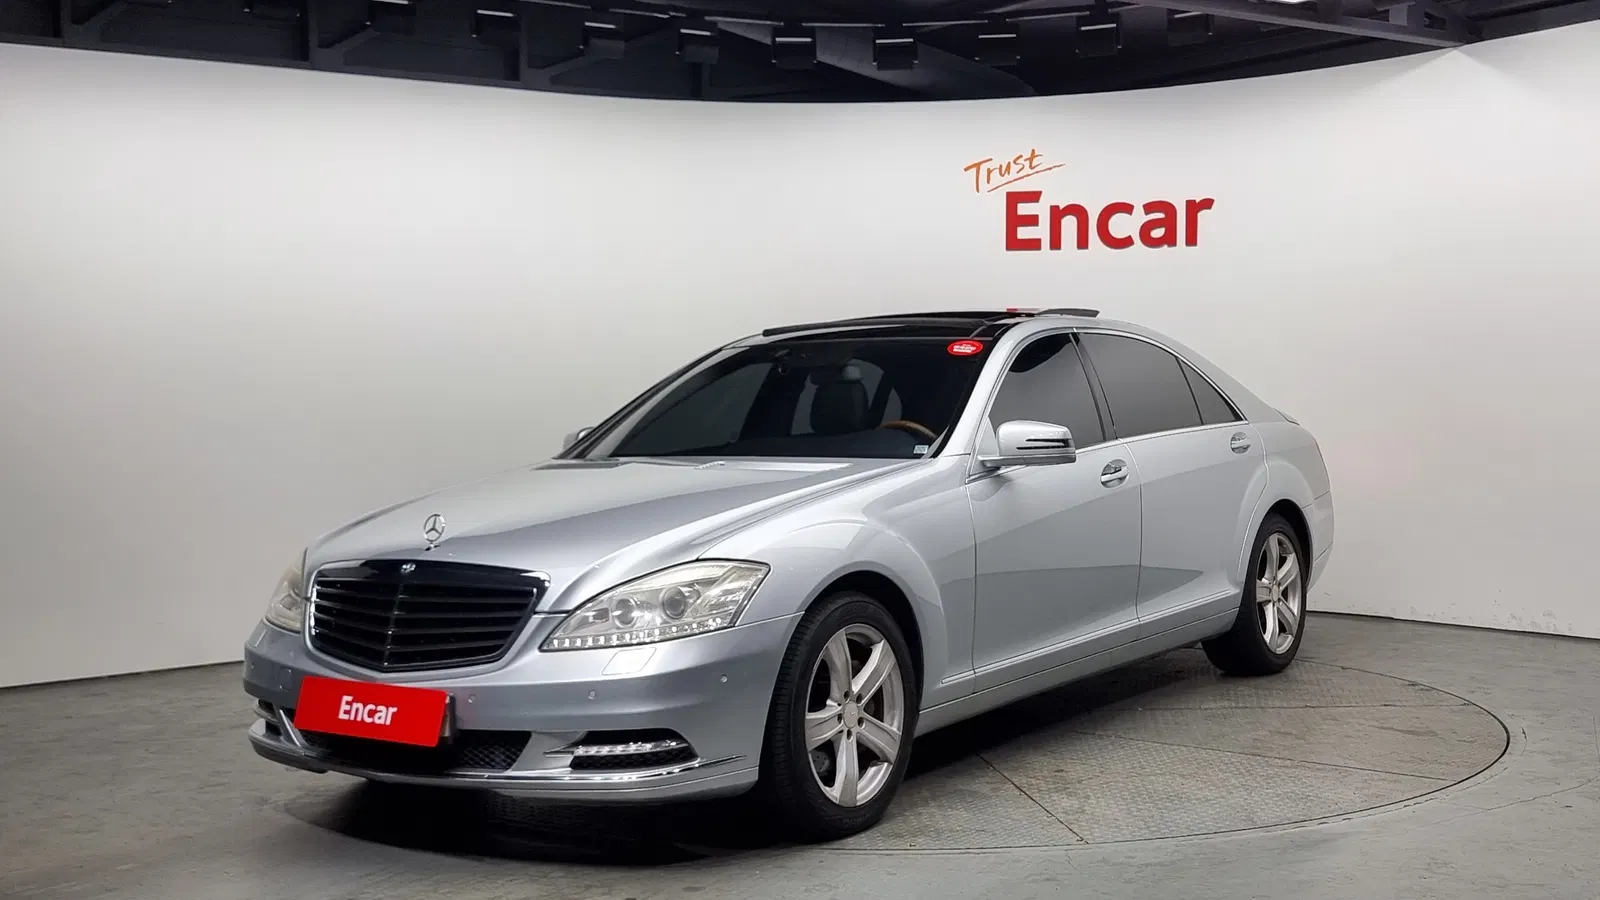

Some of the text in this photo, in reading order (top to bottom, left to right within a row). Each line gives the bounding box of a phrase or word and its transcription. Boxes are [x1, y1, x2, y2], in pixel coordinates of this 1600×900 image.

[964, 148, 1045, 193] Trust
[1005, 190, 1215, 251] Encar
[338, 695, 397, 726] Encar
